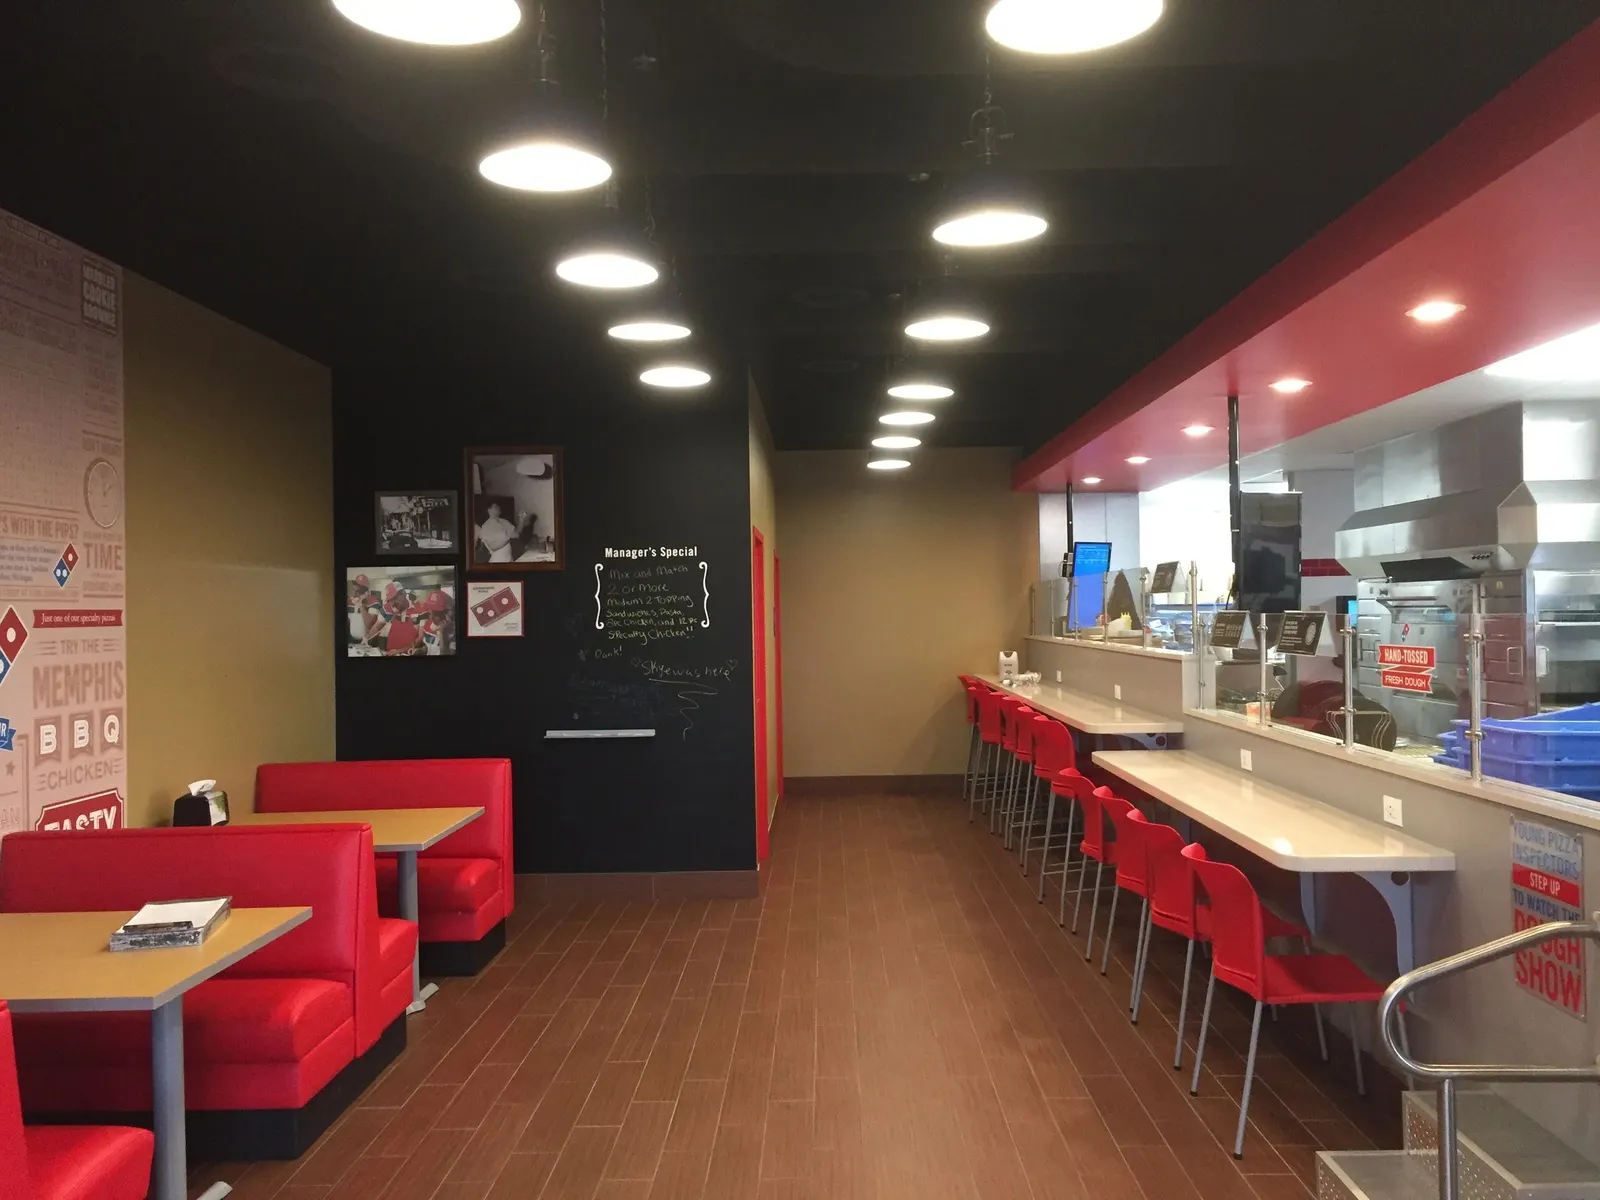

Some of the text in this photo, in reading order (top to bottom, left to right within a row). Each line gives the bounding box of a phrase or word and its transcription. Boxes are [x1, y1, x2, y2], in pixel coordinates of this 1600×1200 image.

[10, 515, 35, 536] WITH
[36, 519, 53, 537] THE
[83, 542, 124, 570] TIME
[604, 546, 698, 559] Manager's Special
[609, 565, 689, 580] Mix and Match
[607, 583, 620, 595] 2
[646, 596, 653, 605] 2
[655, 595, 694, 608] Topping
[40, 613, 53, 625] Just
[63, 613, 71, 622] of
[80, 613, 101, 625] specialty
[60, 638, 100, 655] TRY THE
[1384, 648, 1428, 665] HAND-TOSSED
[32, 660, 124, 710] MEMPHIS
[1385, 675, 1426, 687] FRESH DOUGH
[40, 714, 120, 754] BBQ
[47, 760, 113, 790] CHICKEN
[1513, 821, 1579, 856] YOUNG PIZZA
[1512, 841, 1580, 880] INSPECTORS
[1529, 871, 1561, 896] STEP UP
[1512, 887, 1525, 906] TO
[1526, 894, 1560, 921] WATCH
[1514, 908, 1581, 968] DGH
[1515, 950, 1582, 1013] SHOW
